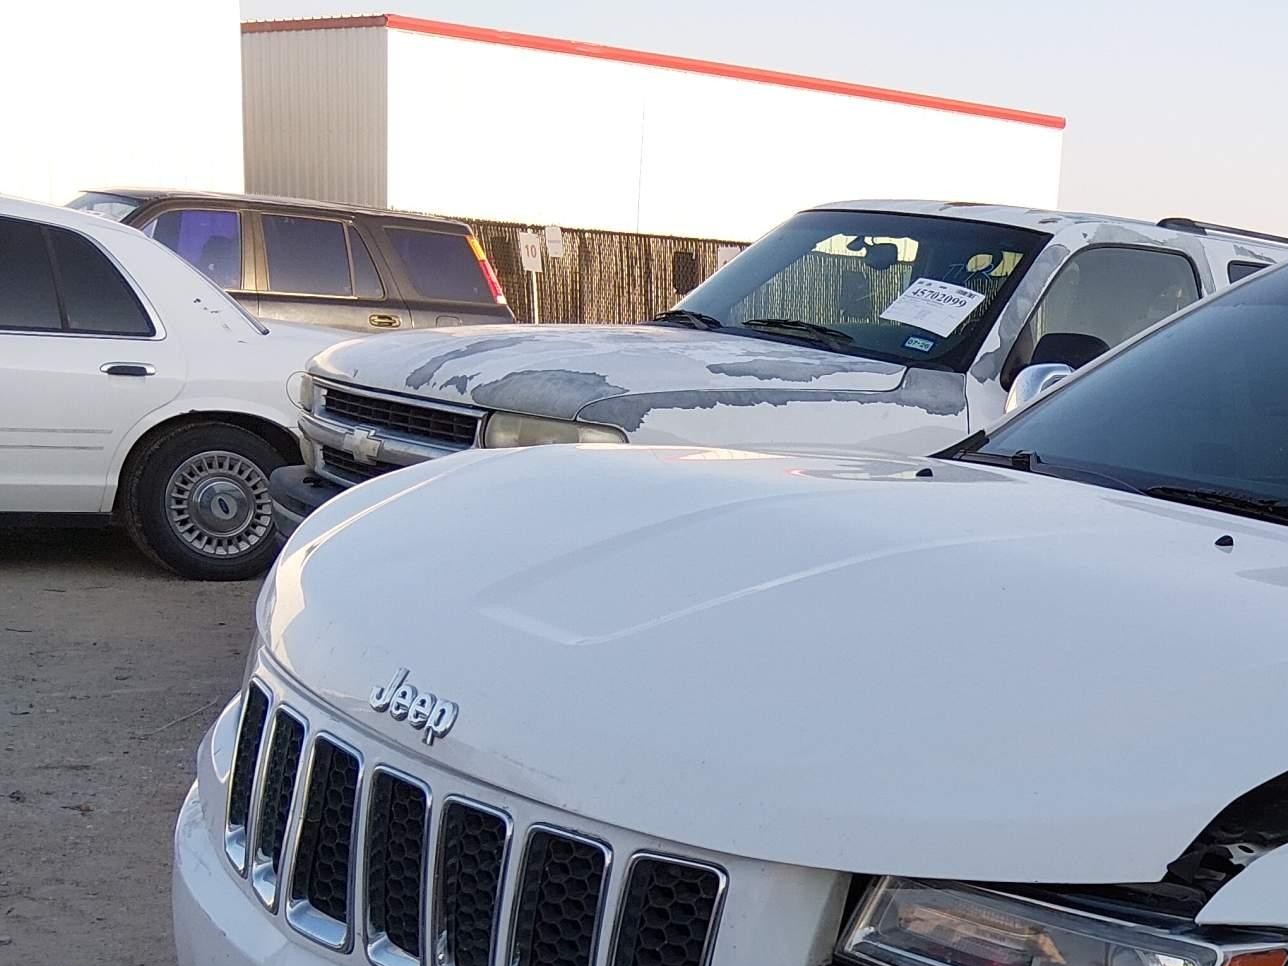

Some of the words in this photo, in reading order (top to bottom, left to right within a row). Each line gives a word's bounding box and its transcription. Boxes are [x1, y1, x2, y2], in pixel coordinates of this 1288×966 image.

[524, 244, 537, 258] 10
[911, 288, 967, 308] 45702099
[370, 667, 460, 746] Jeep
